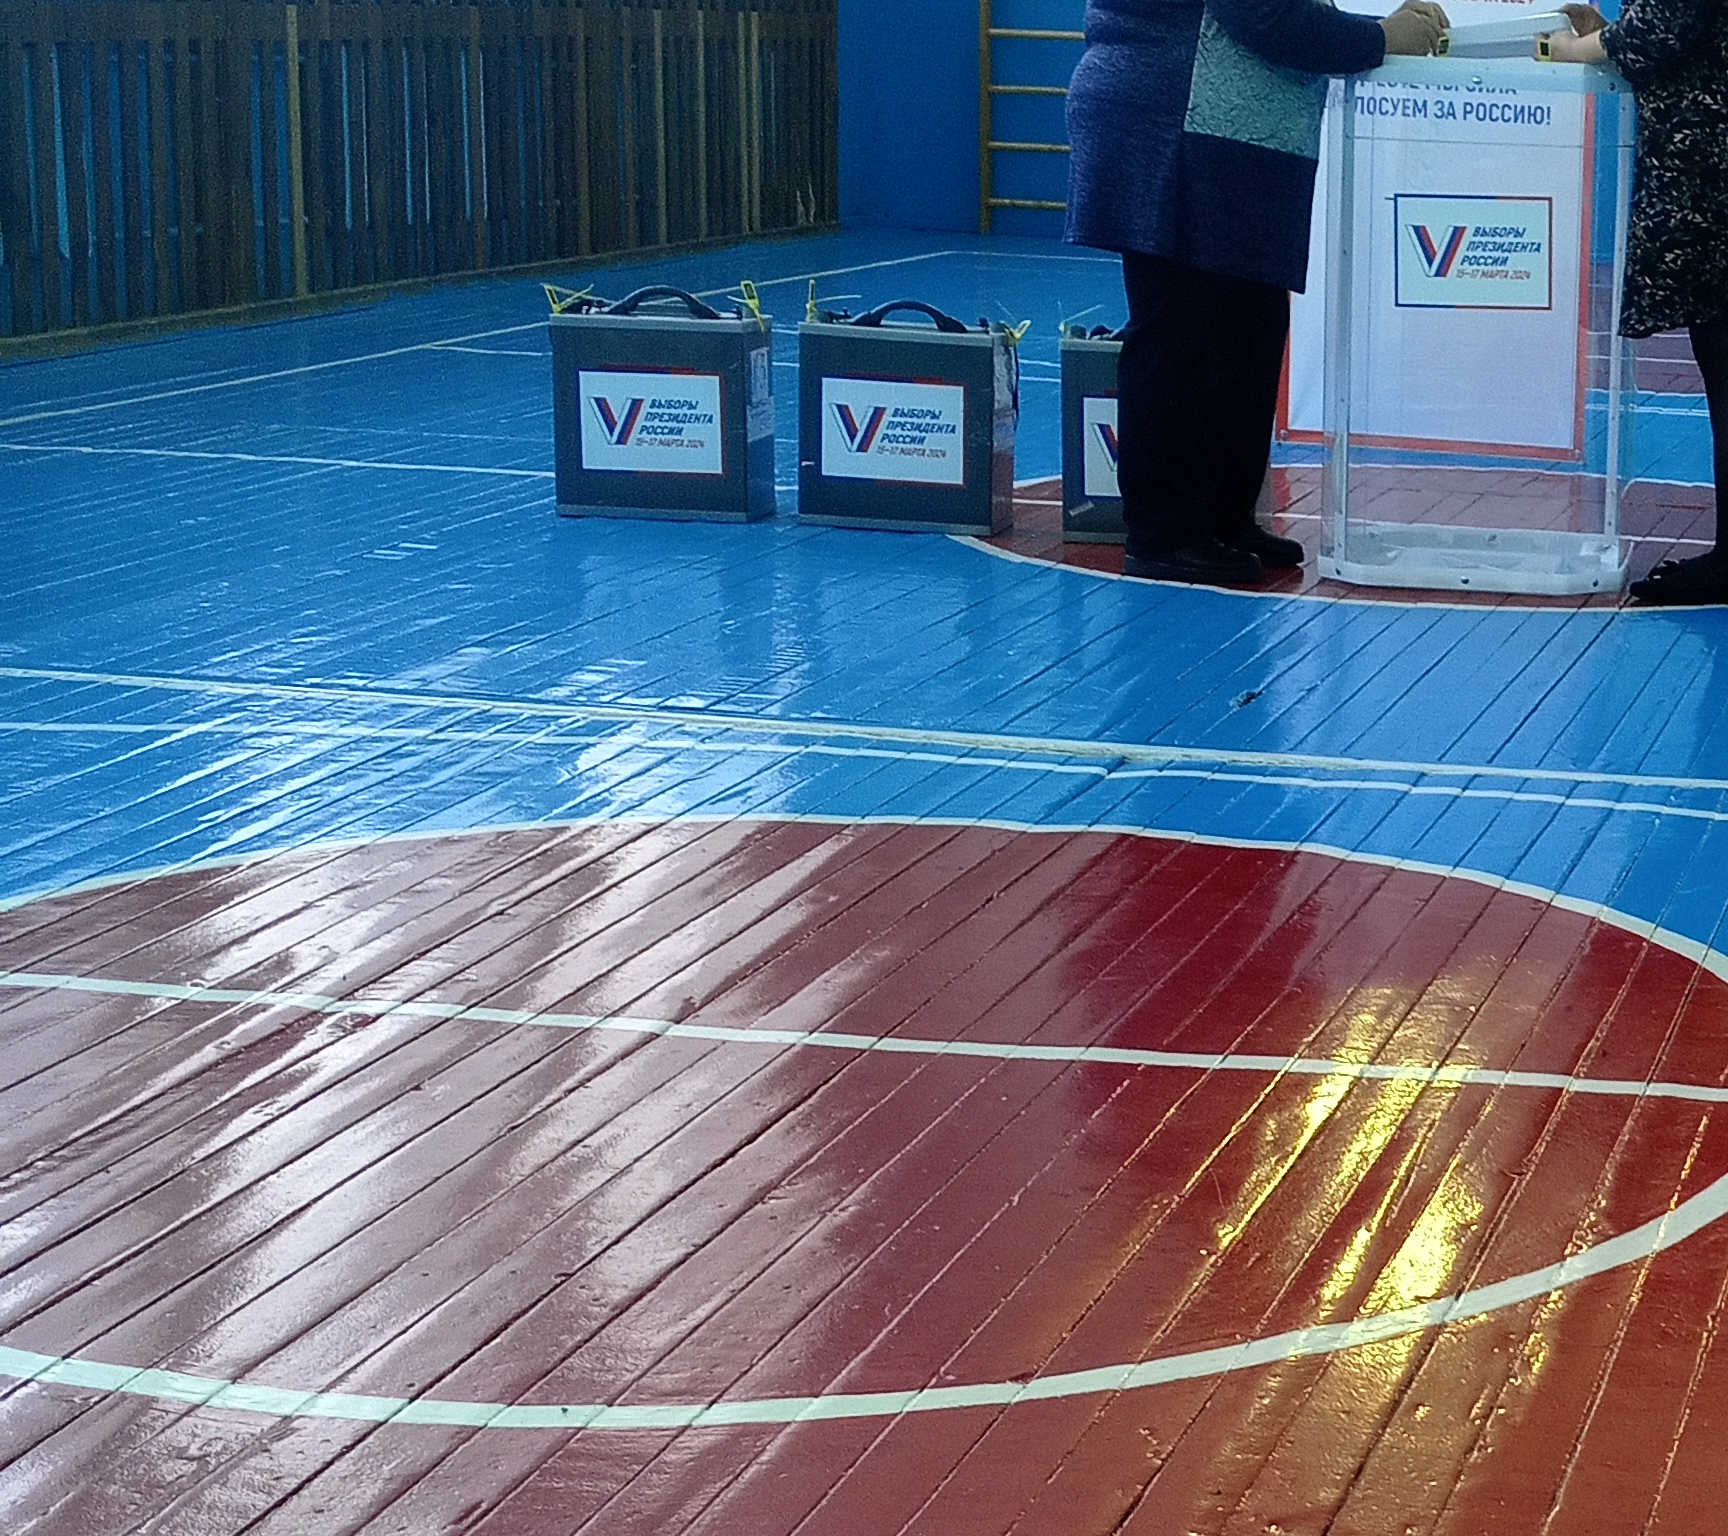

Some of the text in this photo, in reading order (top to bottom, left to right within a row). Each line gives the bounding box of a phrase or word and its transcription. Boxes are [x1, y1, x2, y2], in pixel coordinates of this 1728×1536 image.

[1433, 100, 1457, 121] ЗА
[1462, 101, 1551, 126] РОССИЮ!
[1472, 226, 1526, 238] ВЫБОРЫ
[1466, 240, 1541, 254] ПРЕЗИДЕНТА
[1460, 255, 1509, 267] РОССИИ
[1480, 269, 1509, 279] МАРТА
[649, 398, 699, 410] ВЫБОРЫ
[644, 411, 714, 424] ПРЕЗИДЕНТА
[891, 408, 942, 420] ВЫБОРЫ
[638, 425, 684, 436] РОССИИ
[886, 421, 957, 434] ПРЕЗИДЕНТА
[880, 434, 927, 446] РОССИИ
